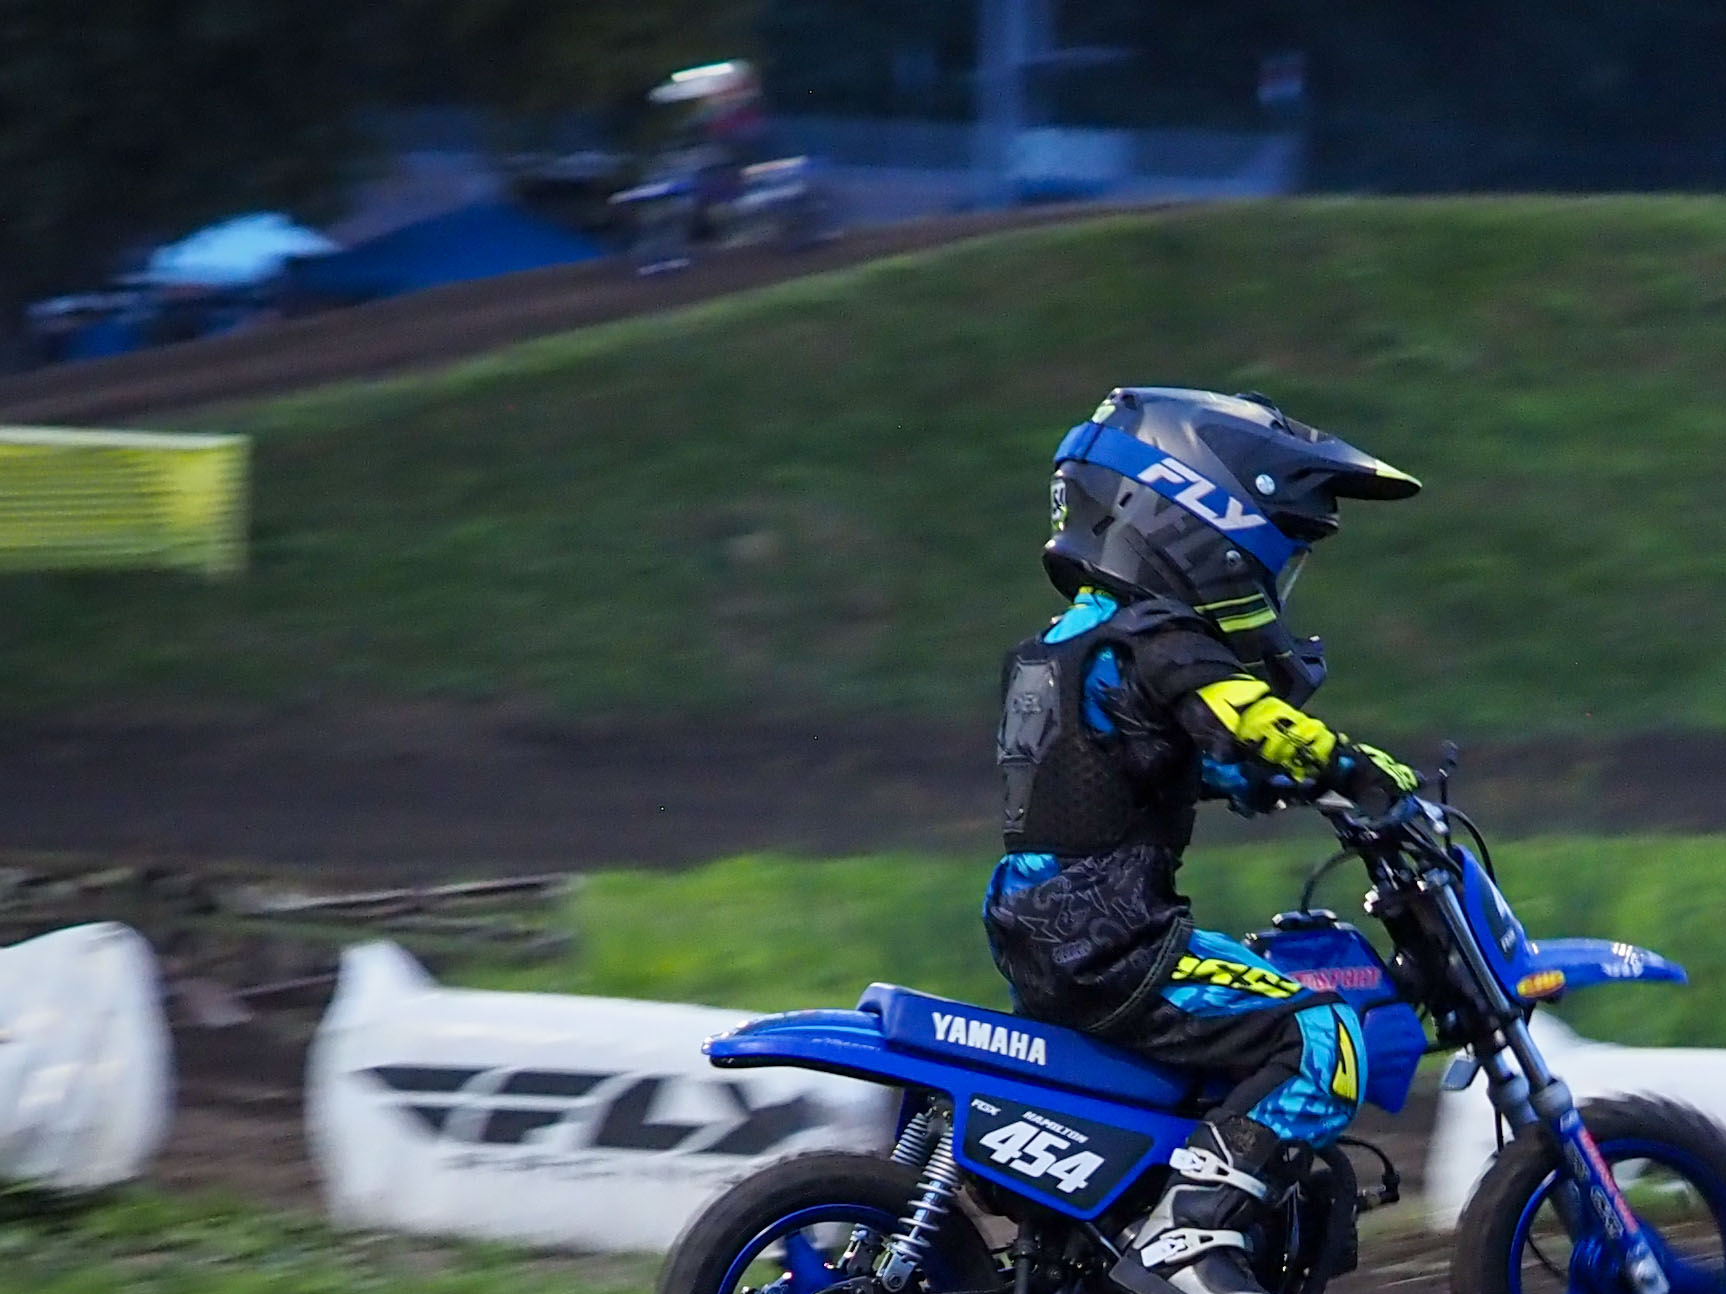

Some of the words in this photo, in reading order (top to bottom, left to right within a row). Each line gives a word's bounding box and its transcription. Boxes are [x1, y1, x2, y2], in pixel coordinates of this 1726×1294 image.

[1137, 457, 1268, 531] FLY
[932, 1012, 1047, 1066] YAMAHA
[358, 1063, 828, 1156] FLY
[1022, 1111, 1089, 1144] HAMILTON
[978, 1120, 1105, 1193] 454
